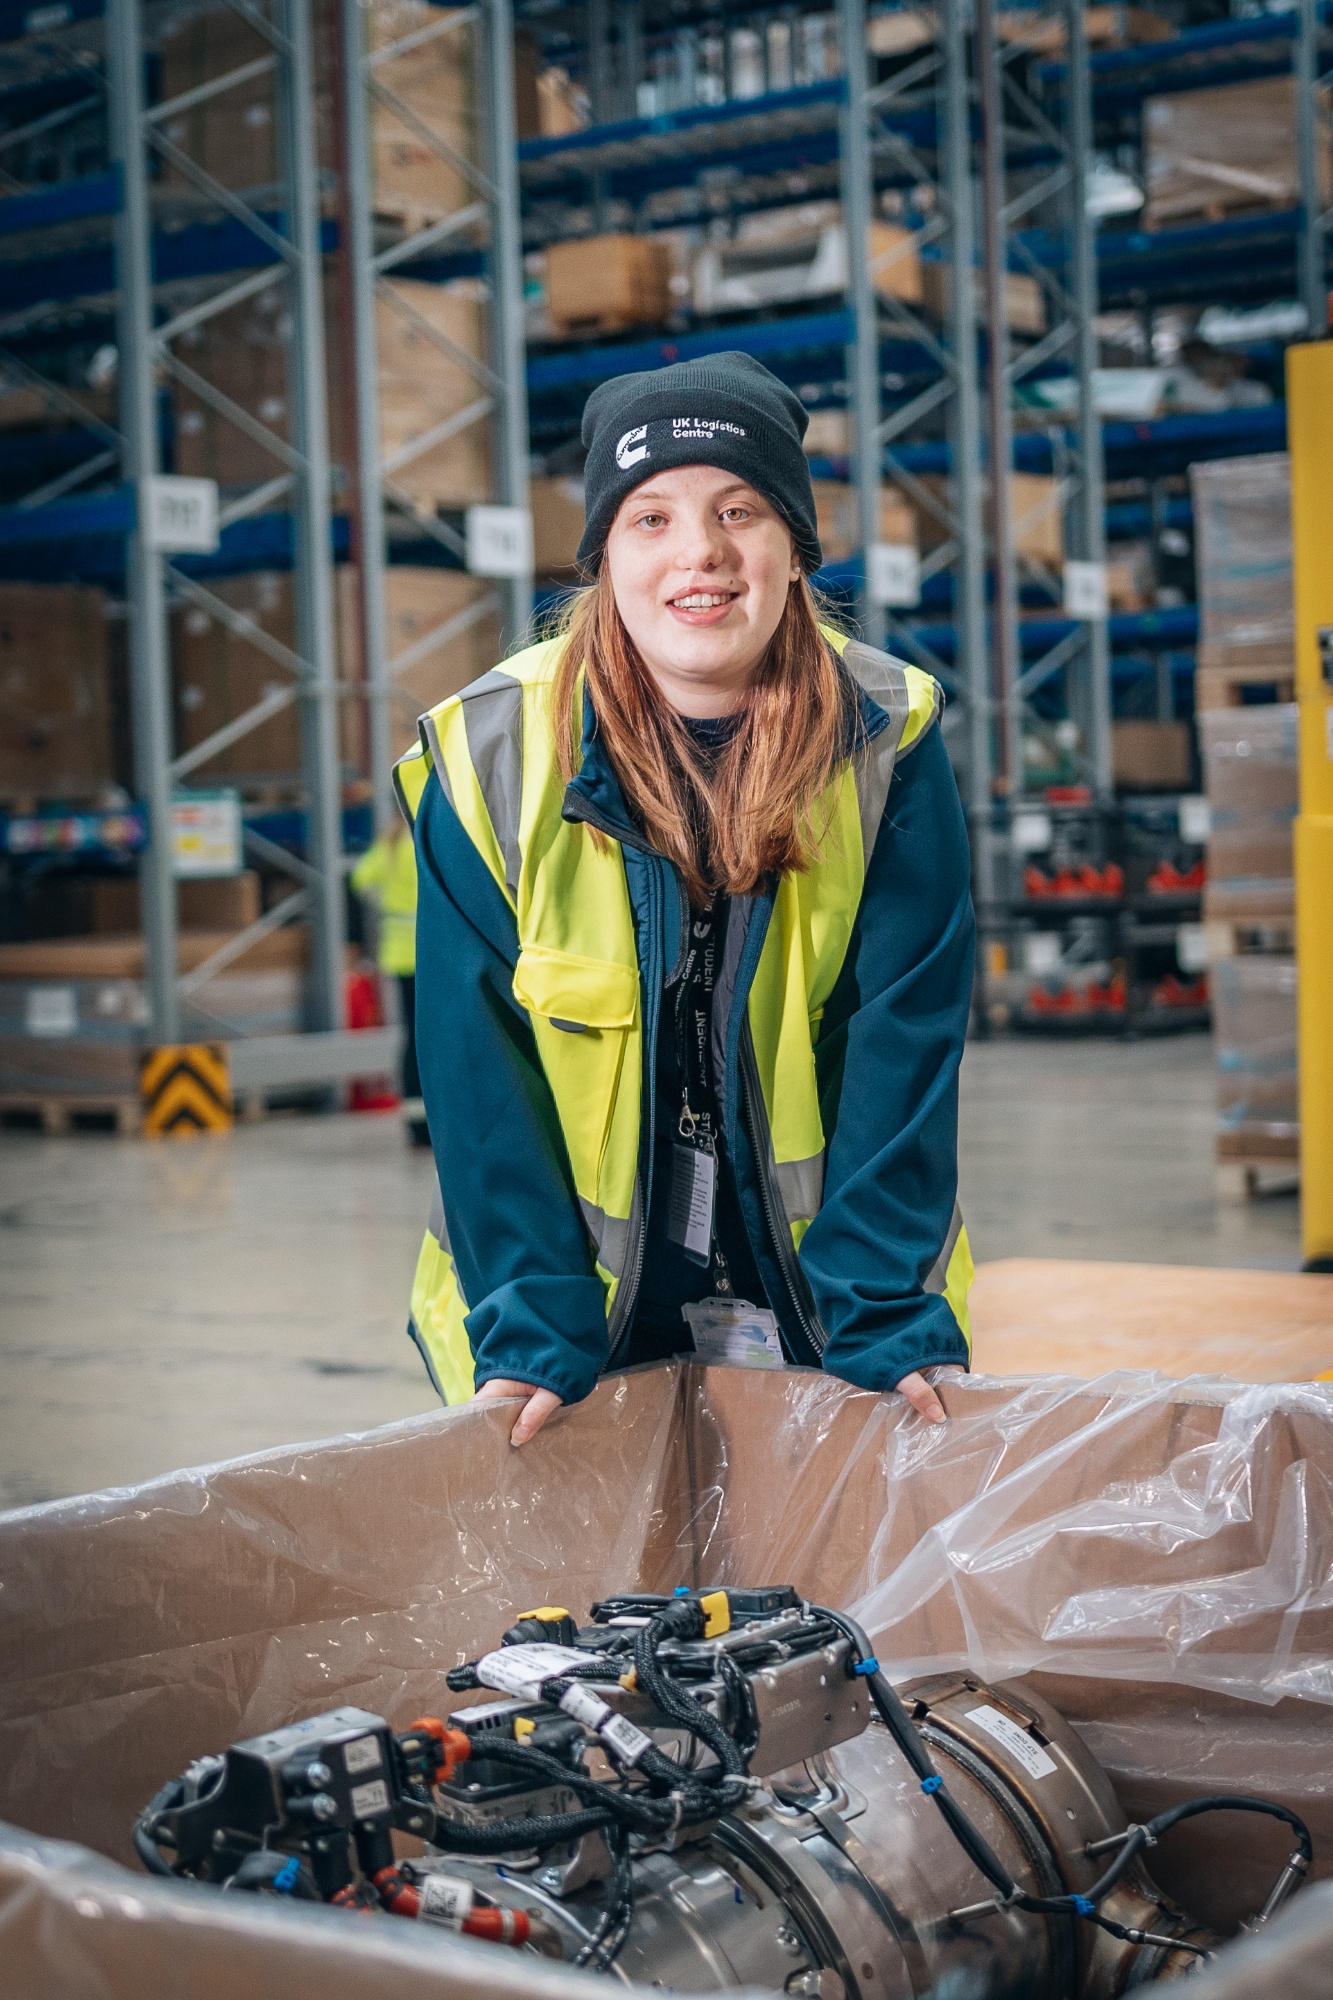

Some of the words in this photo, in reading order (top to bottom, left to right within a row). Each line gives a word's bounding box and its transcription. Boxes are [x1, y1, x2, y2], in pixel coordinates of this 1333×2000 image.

[672, 418, 690, 428] UK
[694, 418, 746, 436] Logistics
[672, 428, 714, 439] Centre
[681, 949, 698, 980] Centre
